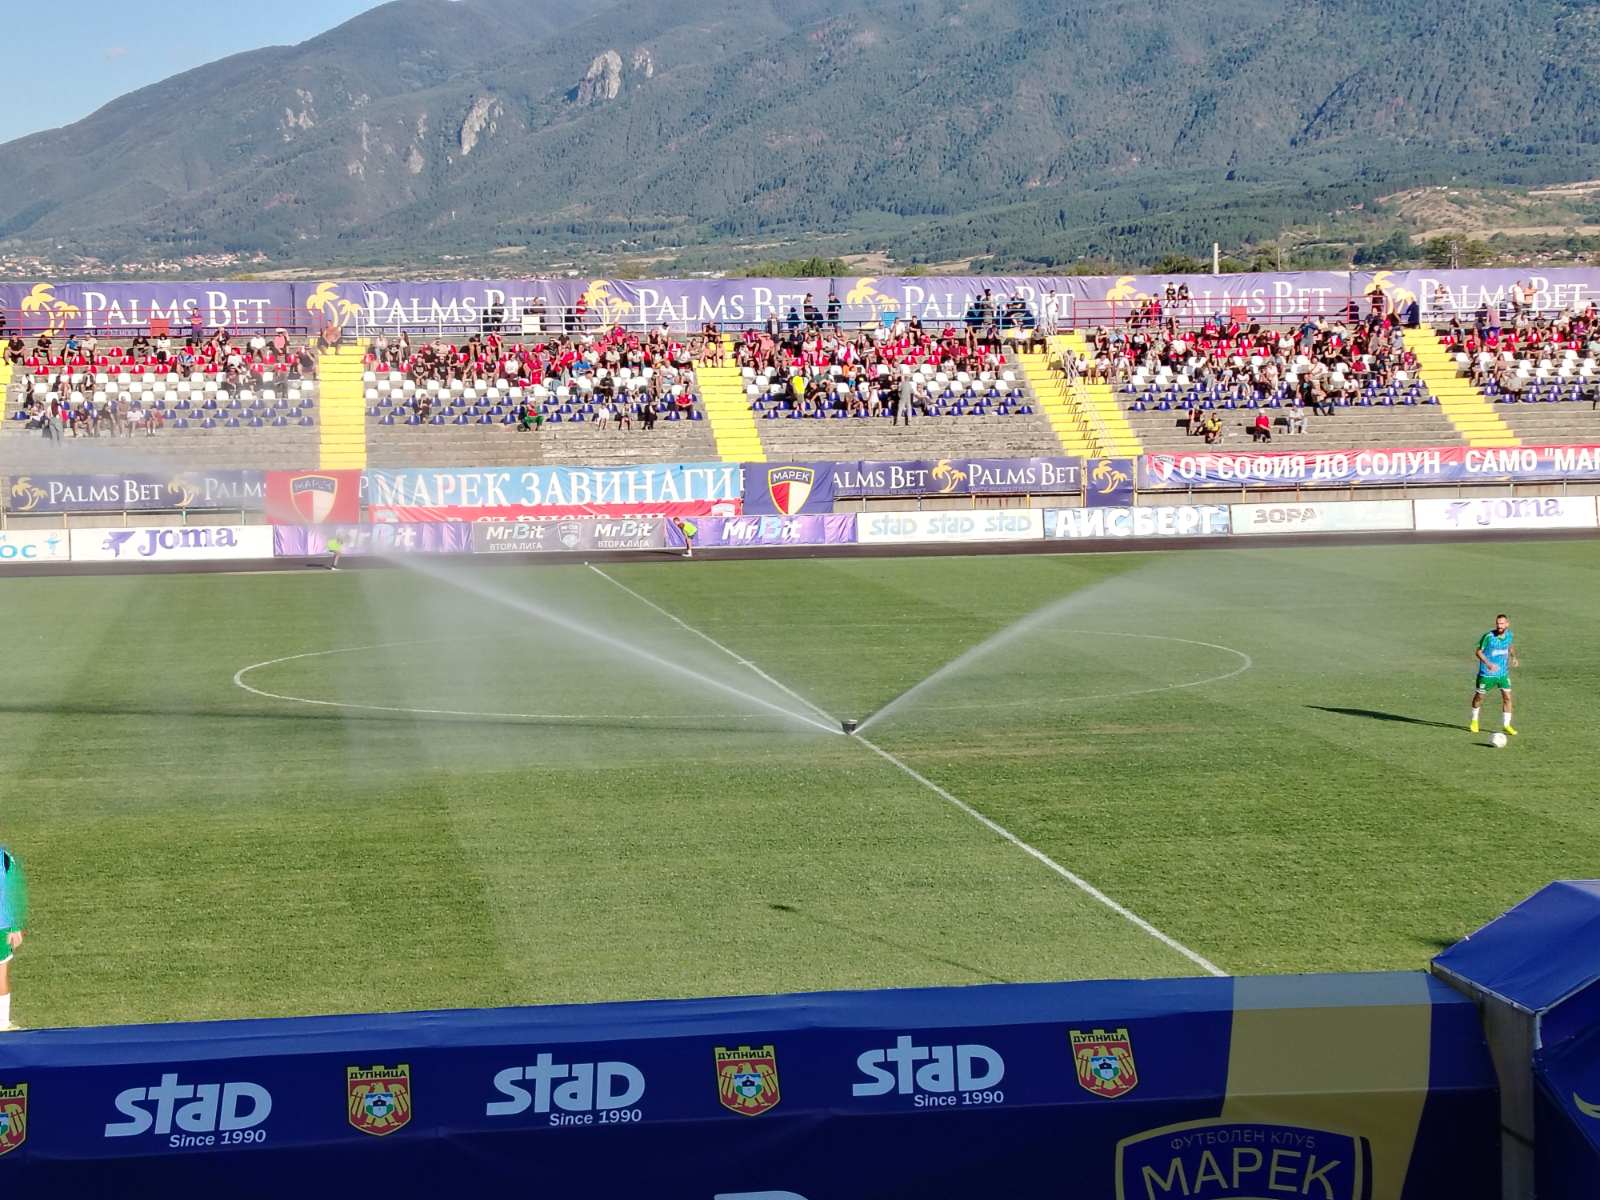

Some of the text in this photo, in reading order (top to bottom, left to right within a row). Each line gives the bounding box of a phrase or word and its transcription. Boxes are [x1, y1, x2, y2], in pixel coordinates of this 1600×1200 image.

[205, 291, 271, 328] BET
[365, 290, 476, 327] PALMS
[638, 288, 744, 324] PALMS
[1273, 281, 1332, 315] BET
[772, 470, 810, 482] МАРЕК
[890, 465, 928, 488] BET
[968, 462, 1079, 487] PALMS BET
[1180, 456, 1213, 479] ОТ
[1217, 455, 1305, 479] СОФИЯ
[1312, 455, 1349, 479] ДО
[1356, 451, 1441, 476] СОЛУН
[1465, 450, 1538, 473] САМО
[48, 479, 163, 504] PALMS BET
[374, 473, 511, 508] МАРЕК
[520, 467, 735, 506] ЗАВИНАГИ
[1253, 507, 1318, 525] ЗОРА
[1476, 498, 1563, 526] Joma
[137, 527, 239, 557] Joma
[1073, 1032, 1127, 1044] ДУПНИЦА
[717, 1050, 772, 1060] ДУПНИЦА
[350, 1069, 407, 1079] ДУПНИЦА
[914, 1090, 1004, 1108] Since 1990
[549, 1108, 642, 1127] Since 1990
[169, 1129, 266, 1148] Since 1990
[1171, 1129, 1316, 1150] ФУТБОЛЕН КЛУБ
[1142, 1147, 1342, 1200] МАРЕК
